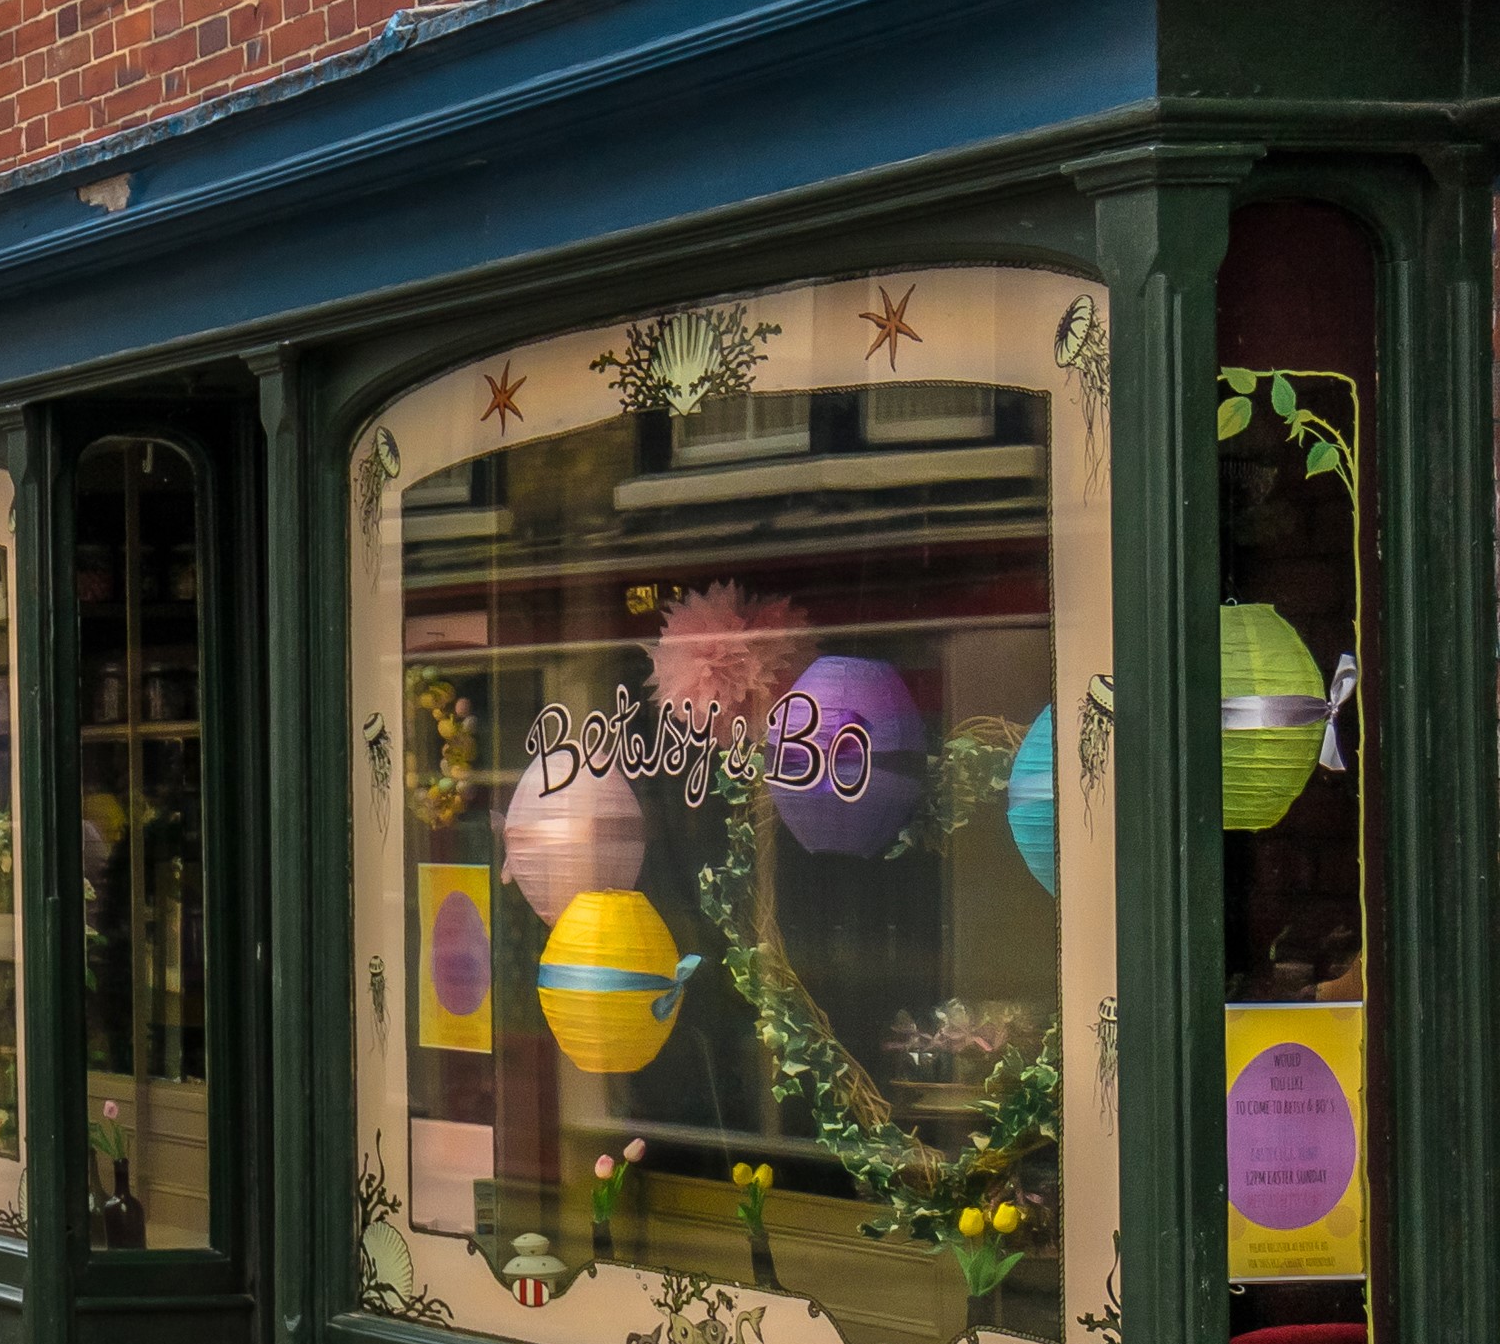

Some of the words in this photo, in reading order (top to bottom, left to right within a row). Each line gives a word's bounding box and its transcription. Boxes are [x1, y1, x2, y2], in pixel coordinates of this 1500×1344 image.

[526, 684, 720, 807] Betsy
[724, 716, 757, 782] &
[1273, 1053, 1300, 1067] WOULD
[1270, 1077, 1285, 1091] YOU
[1287, 1076, 1303, 1091] LIKE
[1236, 1100, 1245, 1115] TO
[1248, 1100, 1269, 1115] COME
[1272, 1100, 1282, 1115] TO
[1267, 1170, 1294, 1186] EASTER
[1296, 1169, 1327, 1185] SUNDAY
